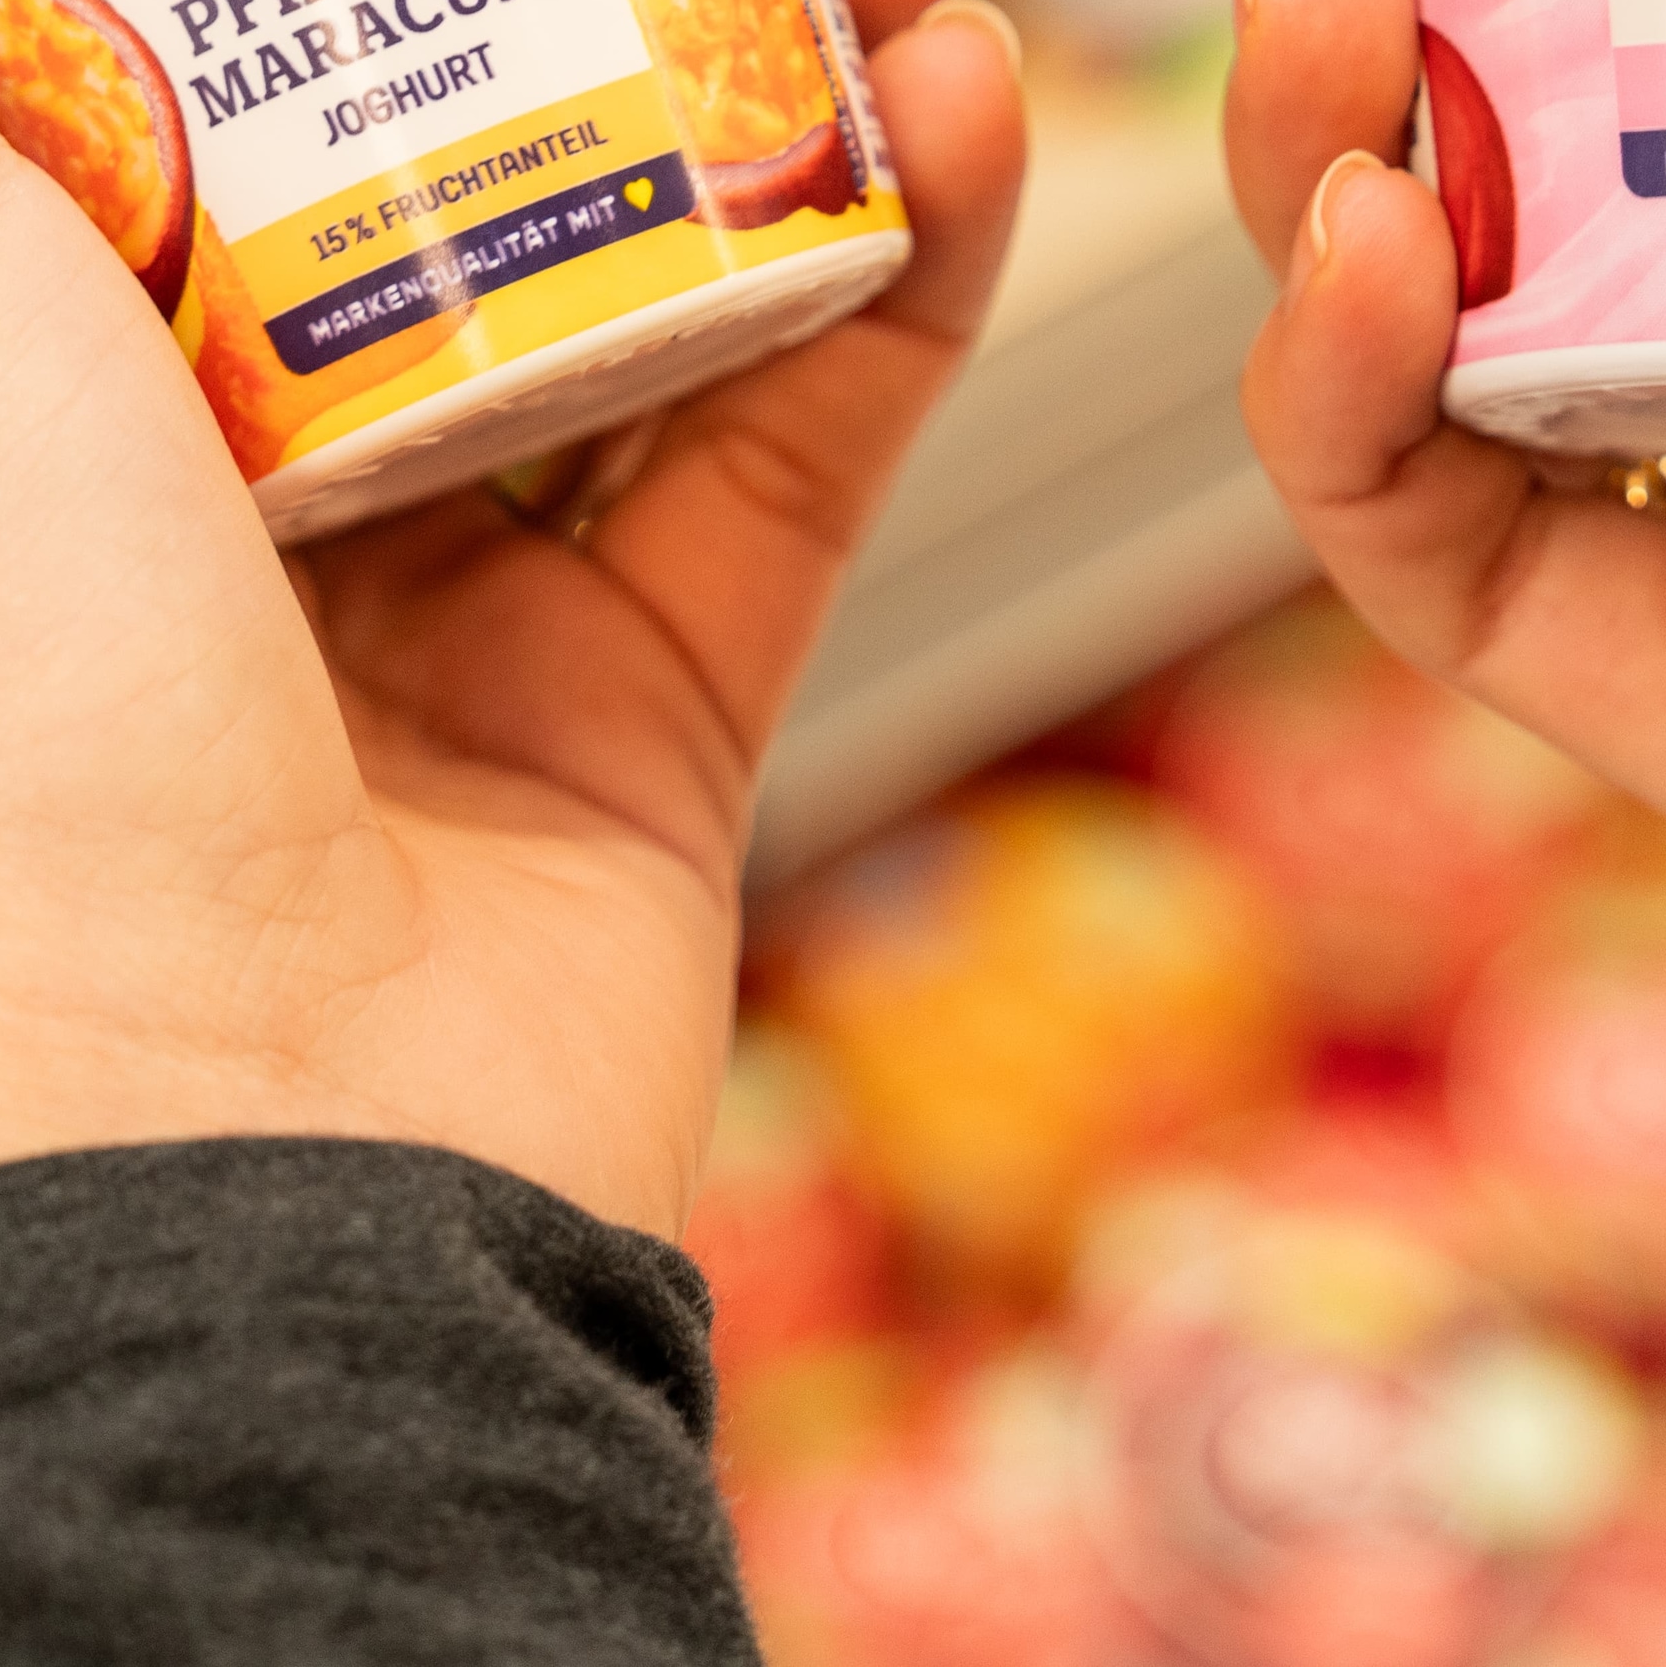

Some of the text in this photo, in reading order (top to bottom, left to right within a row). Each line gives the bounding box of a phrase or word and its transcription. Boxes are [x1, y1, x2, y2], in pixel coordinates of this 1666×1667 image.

[322, 42, 497, 147] JOGHURT
[310, 120, 609, 262] 15% FRUCHTANTEIL
[307, 195, 617, 347] MARKENQUALITÄT MIT
